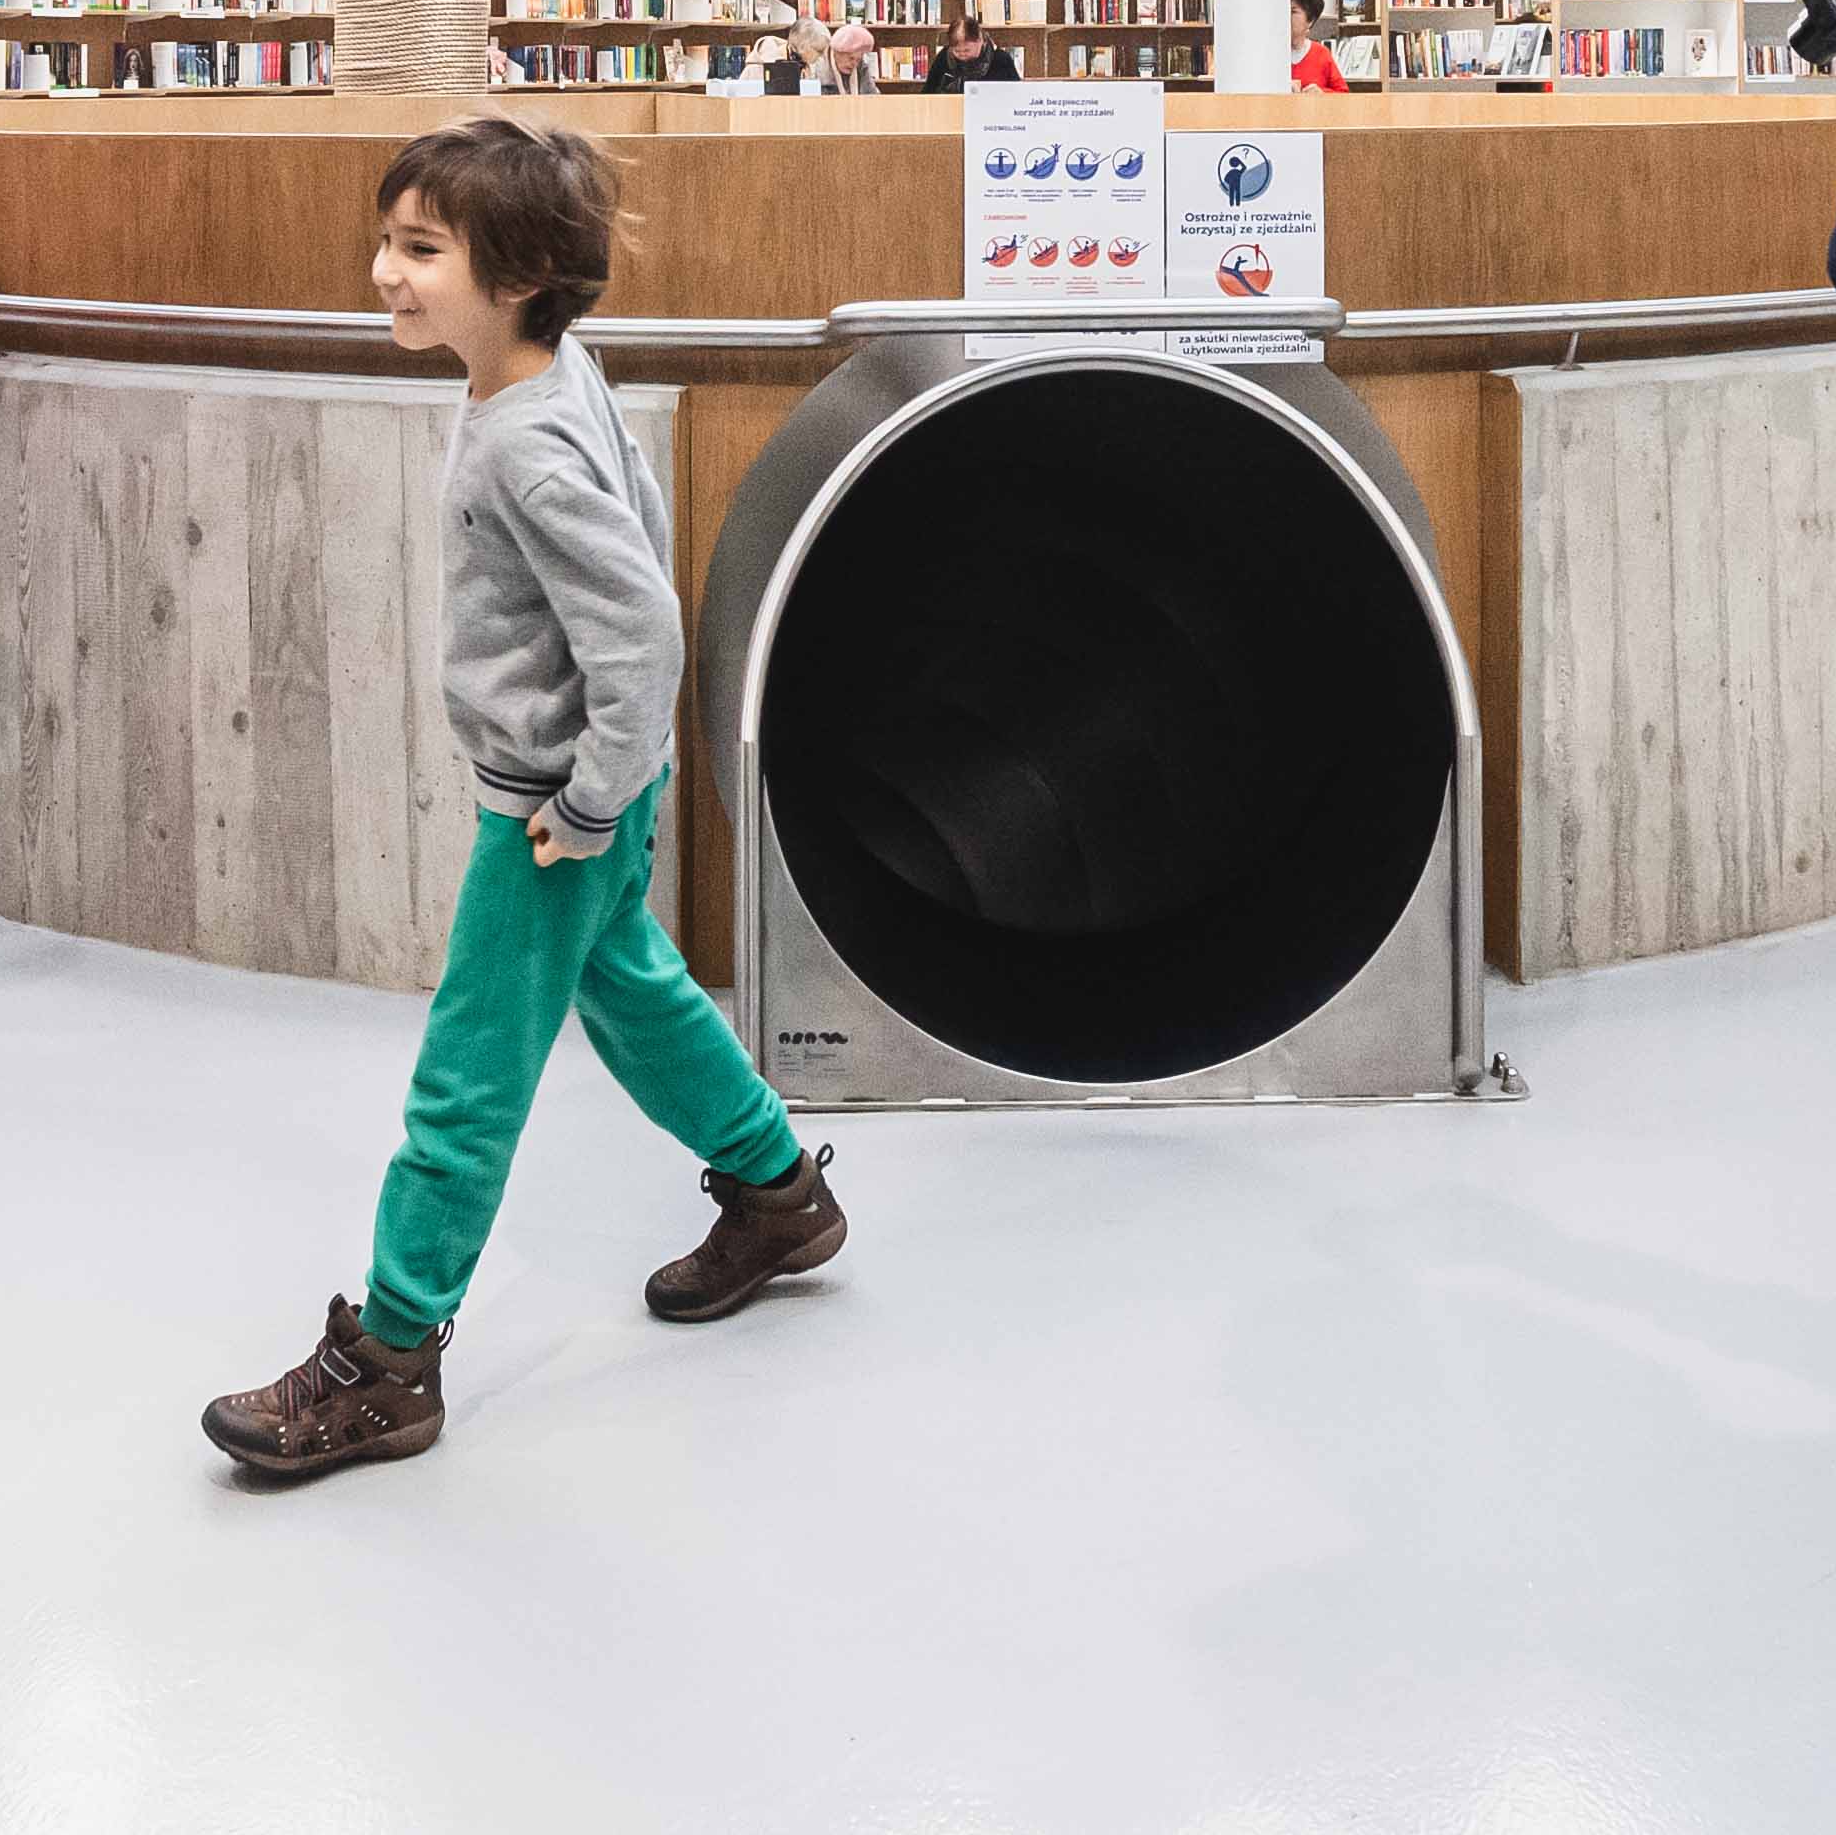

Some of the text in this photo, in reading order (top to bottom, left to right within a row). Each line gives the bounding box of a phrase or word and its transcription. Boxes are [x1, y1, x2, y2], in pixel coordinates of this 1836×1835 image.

[1250, 210, 1313, 222] rozważnie
[1180, 222, 1317, 237] korzystaj ze zjeżdżalni
[1178, 332, 1230, 344] za skutki
[1182, 342, 1311, 356] użytkowania zjeżdżalni
